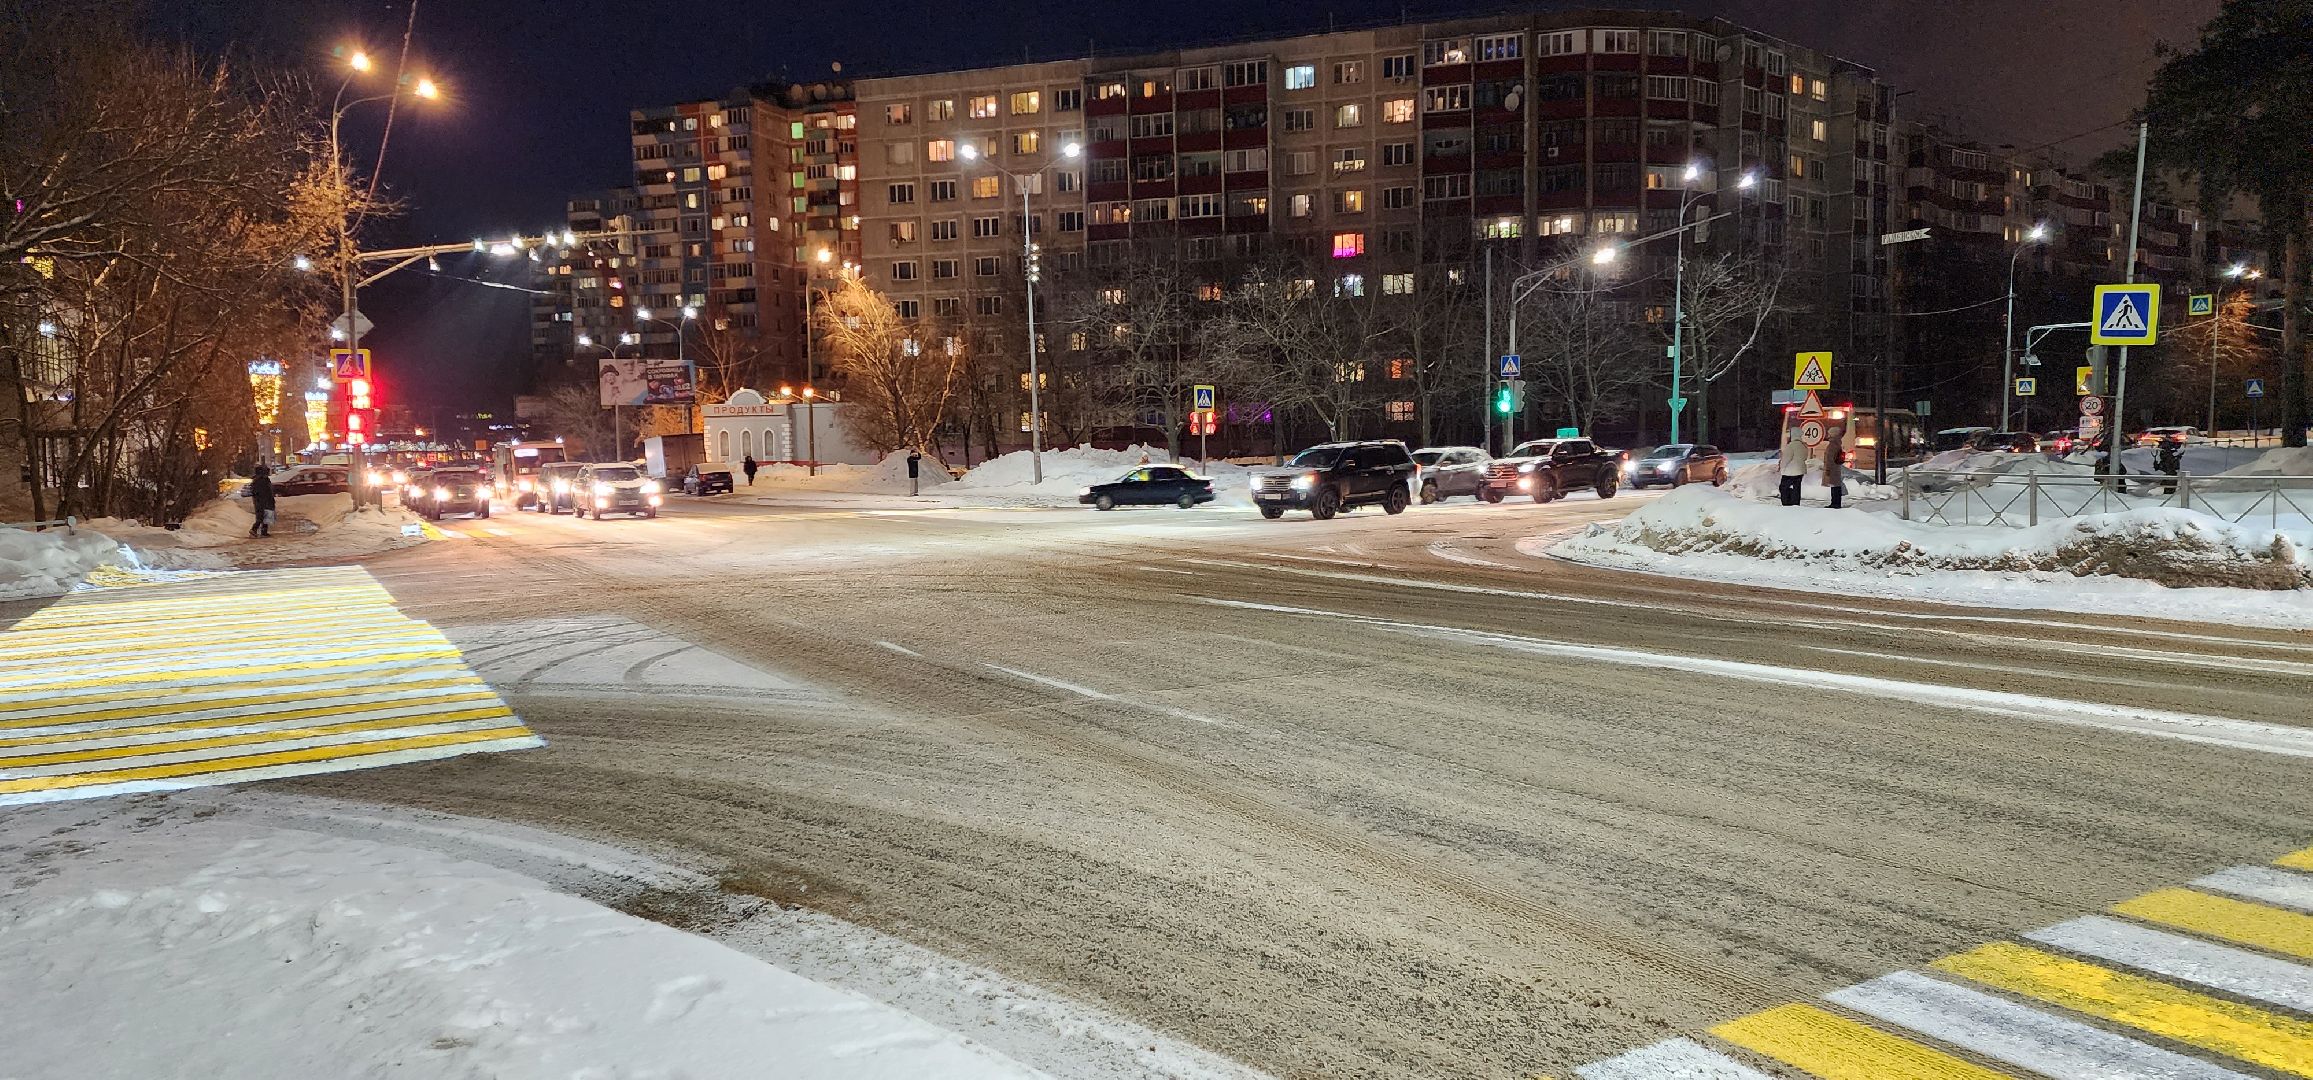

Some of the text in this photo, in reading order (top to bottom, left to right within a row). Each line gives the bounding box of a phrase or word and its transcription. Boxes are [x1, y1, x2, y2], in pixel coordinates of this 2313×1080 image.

[2085, 401, 2098, 410] 20
[713, 406, 774, 415] ПРОДУКТЫ
[1804, 427, 1819, 439] 40
